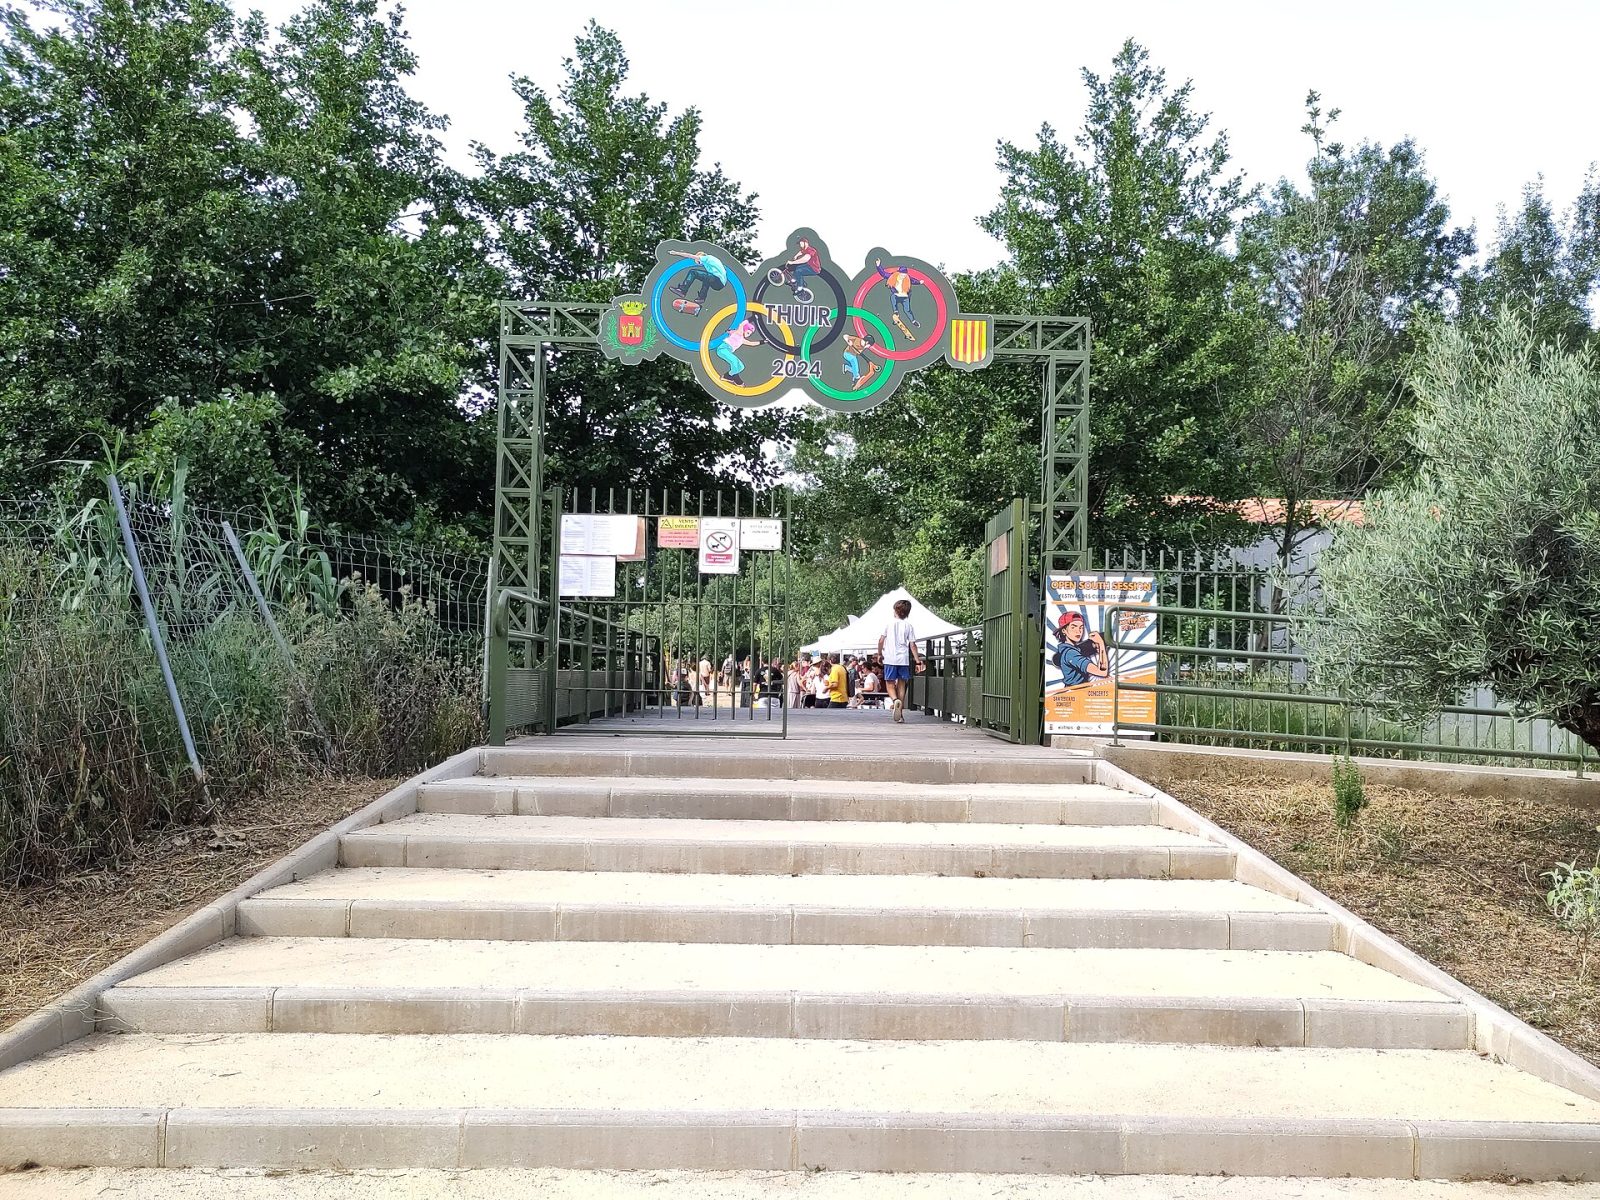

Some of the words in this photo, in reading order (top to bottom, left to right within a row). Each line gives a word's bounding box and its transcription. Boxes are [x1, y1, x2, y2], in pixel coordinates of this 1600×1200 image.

[765, 304, 832, 327] THUIR
[772, 359, 822, 378] 2024
[1051, 581, 1076, 591] OPEN
[1079, 581, 1110, 591] SOUTH
[1112, 582, 1152, 592] SESSION
